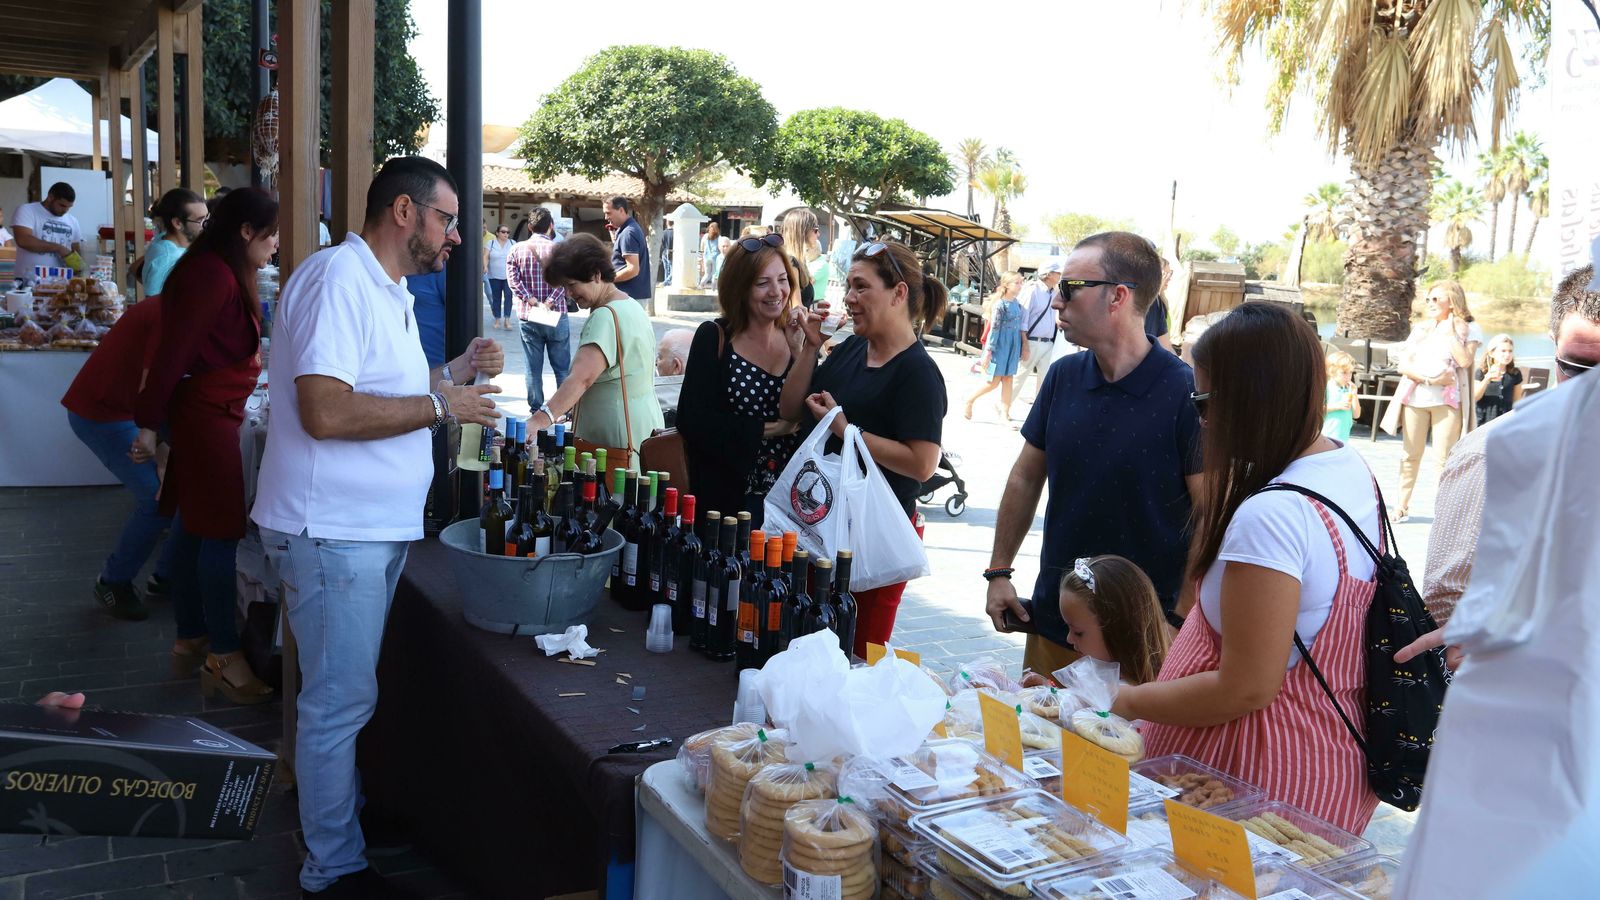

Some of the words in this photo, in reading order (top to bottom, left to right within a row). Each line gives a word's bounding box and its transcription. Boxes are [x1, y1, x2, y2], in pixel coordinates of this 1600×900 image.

[5, 771, 102, 794] OLIVEROS
[110, 778, 197, 800] BODEGAS
[246, 795, 260, 830] PRODUCT
[256, 784, 264, 794] OF
[260, 762, 271, 784] SPAIN
